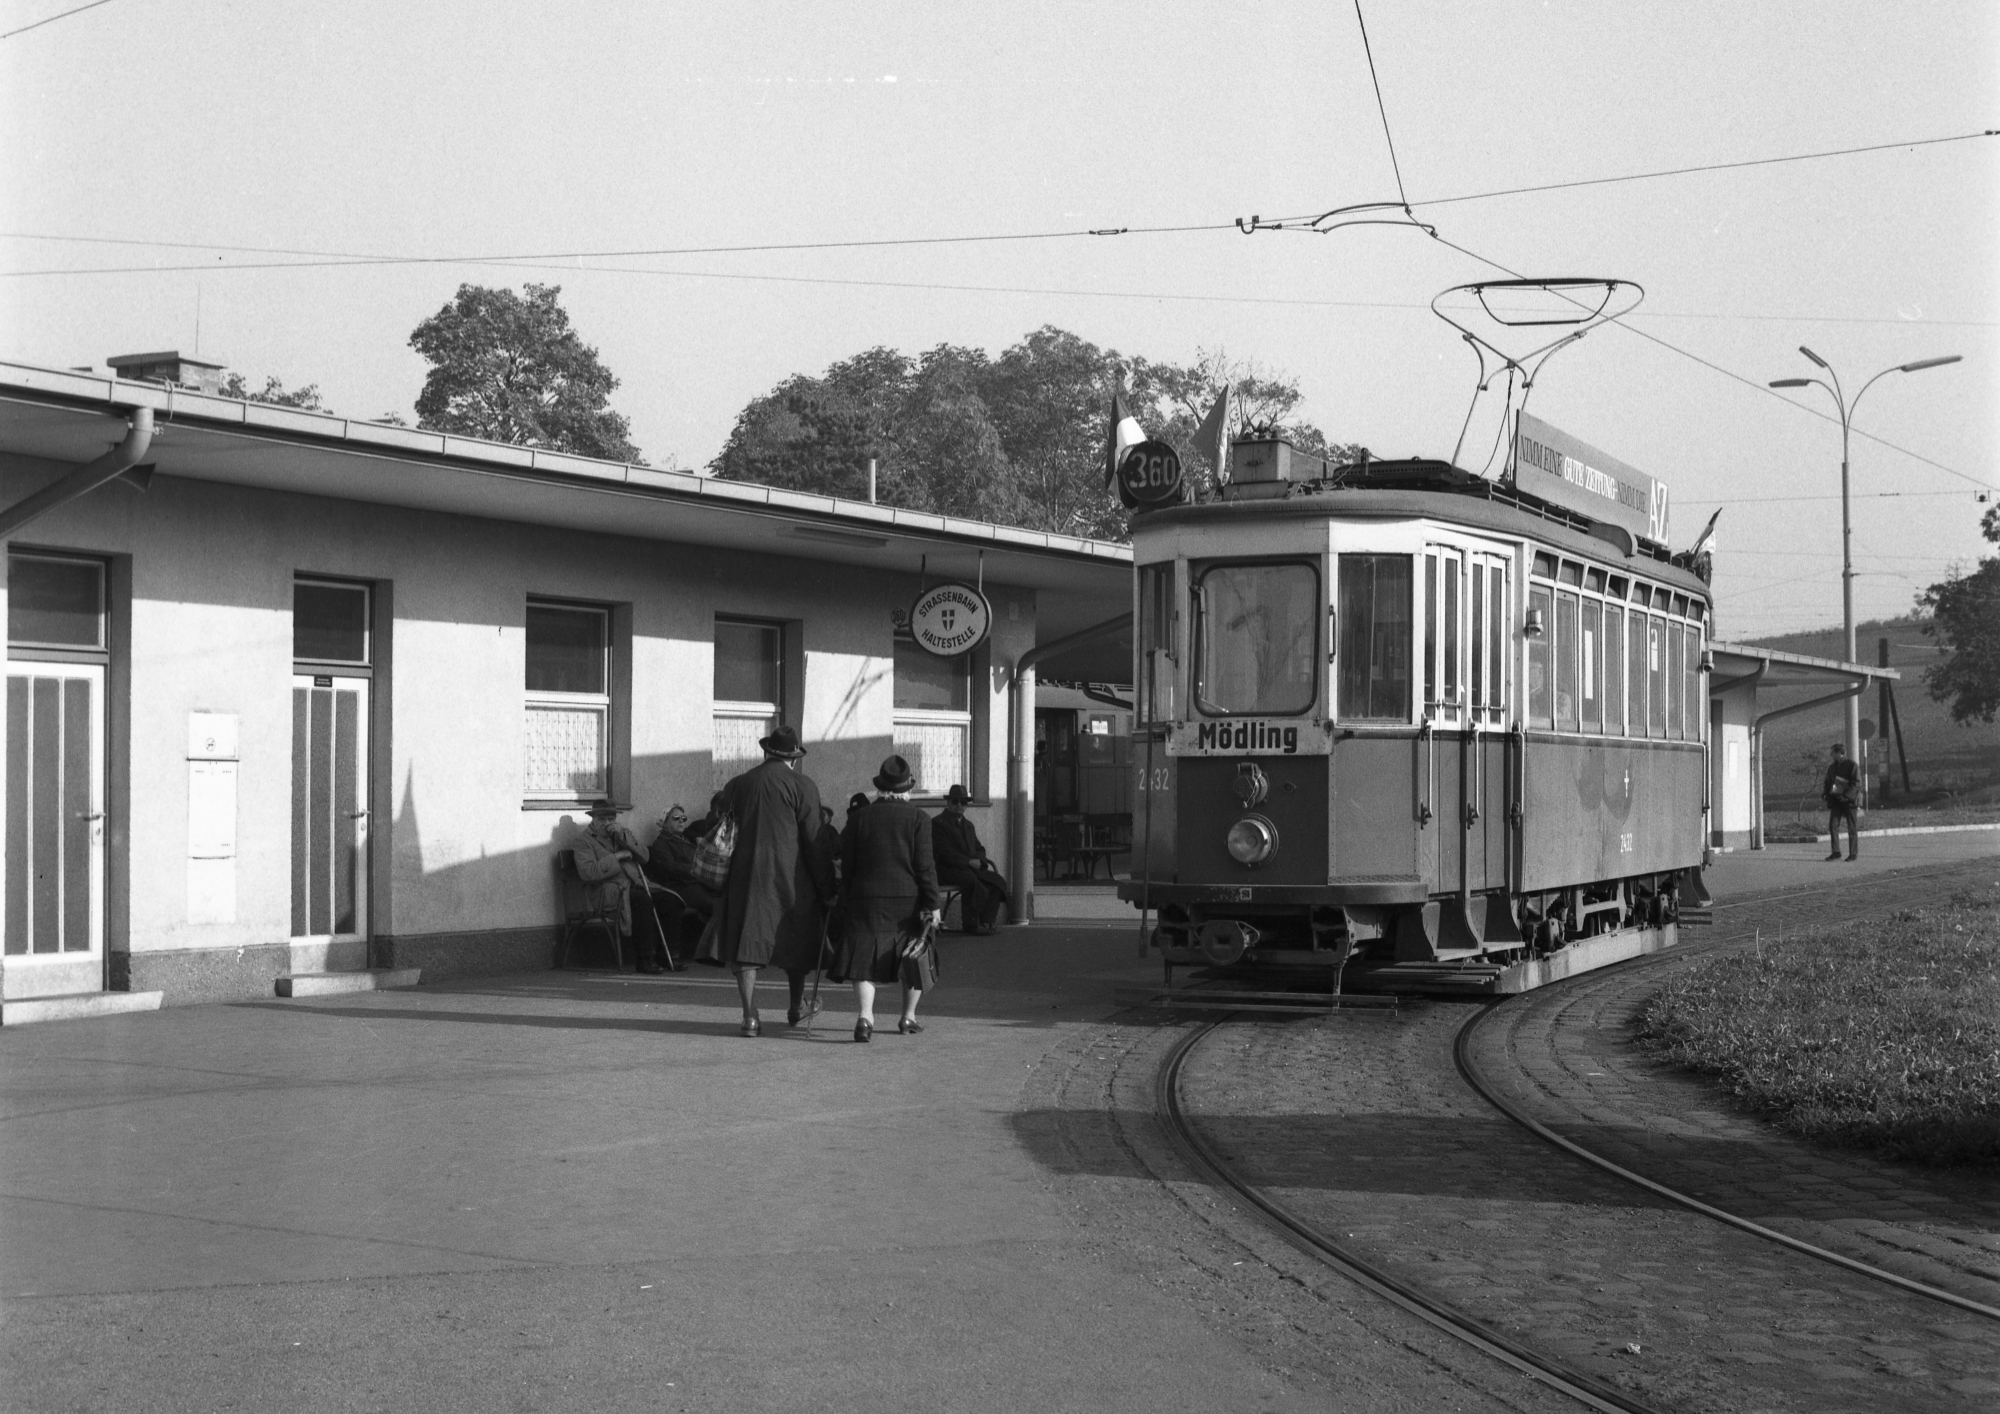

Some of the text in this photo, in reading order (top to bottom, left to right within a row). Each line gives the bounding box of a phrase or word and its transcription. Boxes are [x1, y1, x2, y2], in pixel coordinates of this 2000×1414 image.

[1129, 451, 1176, 488] 360
[1519, 434, 1543, 469] NIMM
[1542, 446, 1562, 477] EINE
[1564, 456, 1584, 488] GUTE
[1648, 478, 1669, 547] AZ
[918, 591, 979, 618] STRASSENBAHN
[921, 625, 976, 649] HALTESTELLE
[1198, 721, 1298, 754] Mödling
[1620, 832, 1633, 853] 2432
